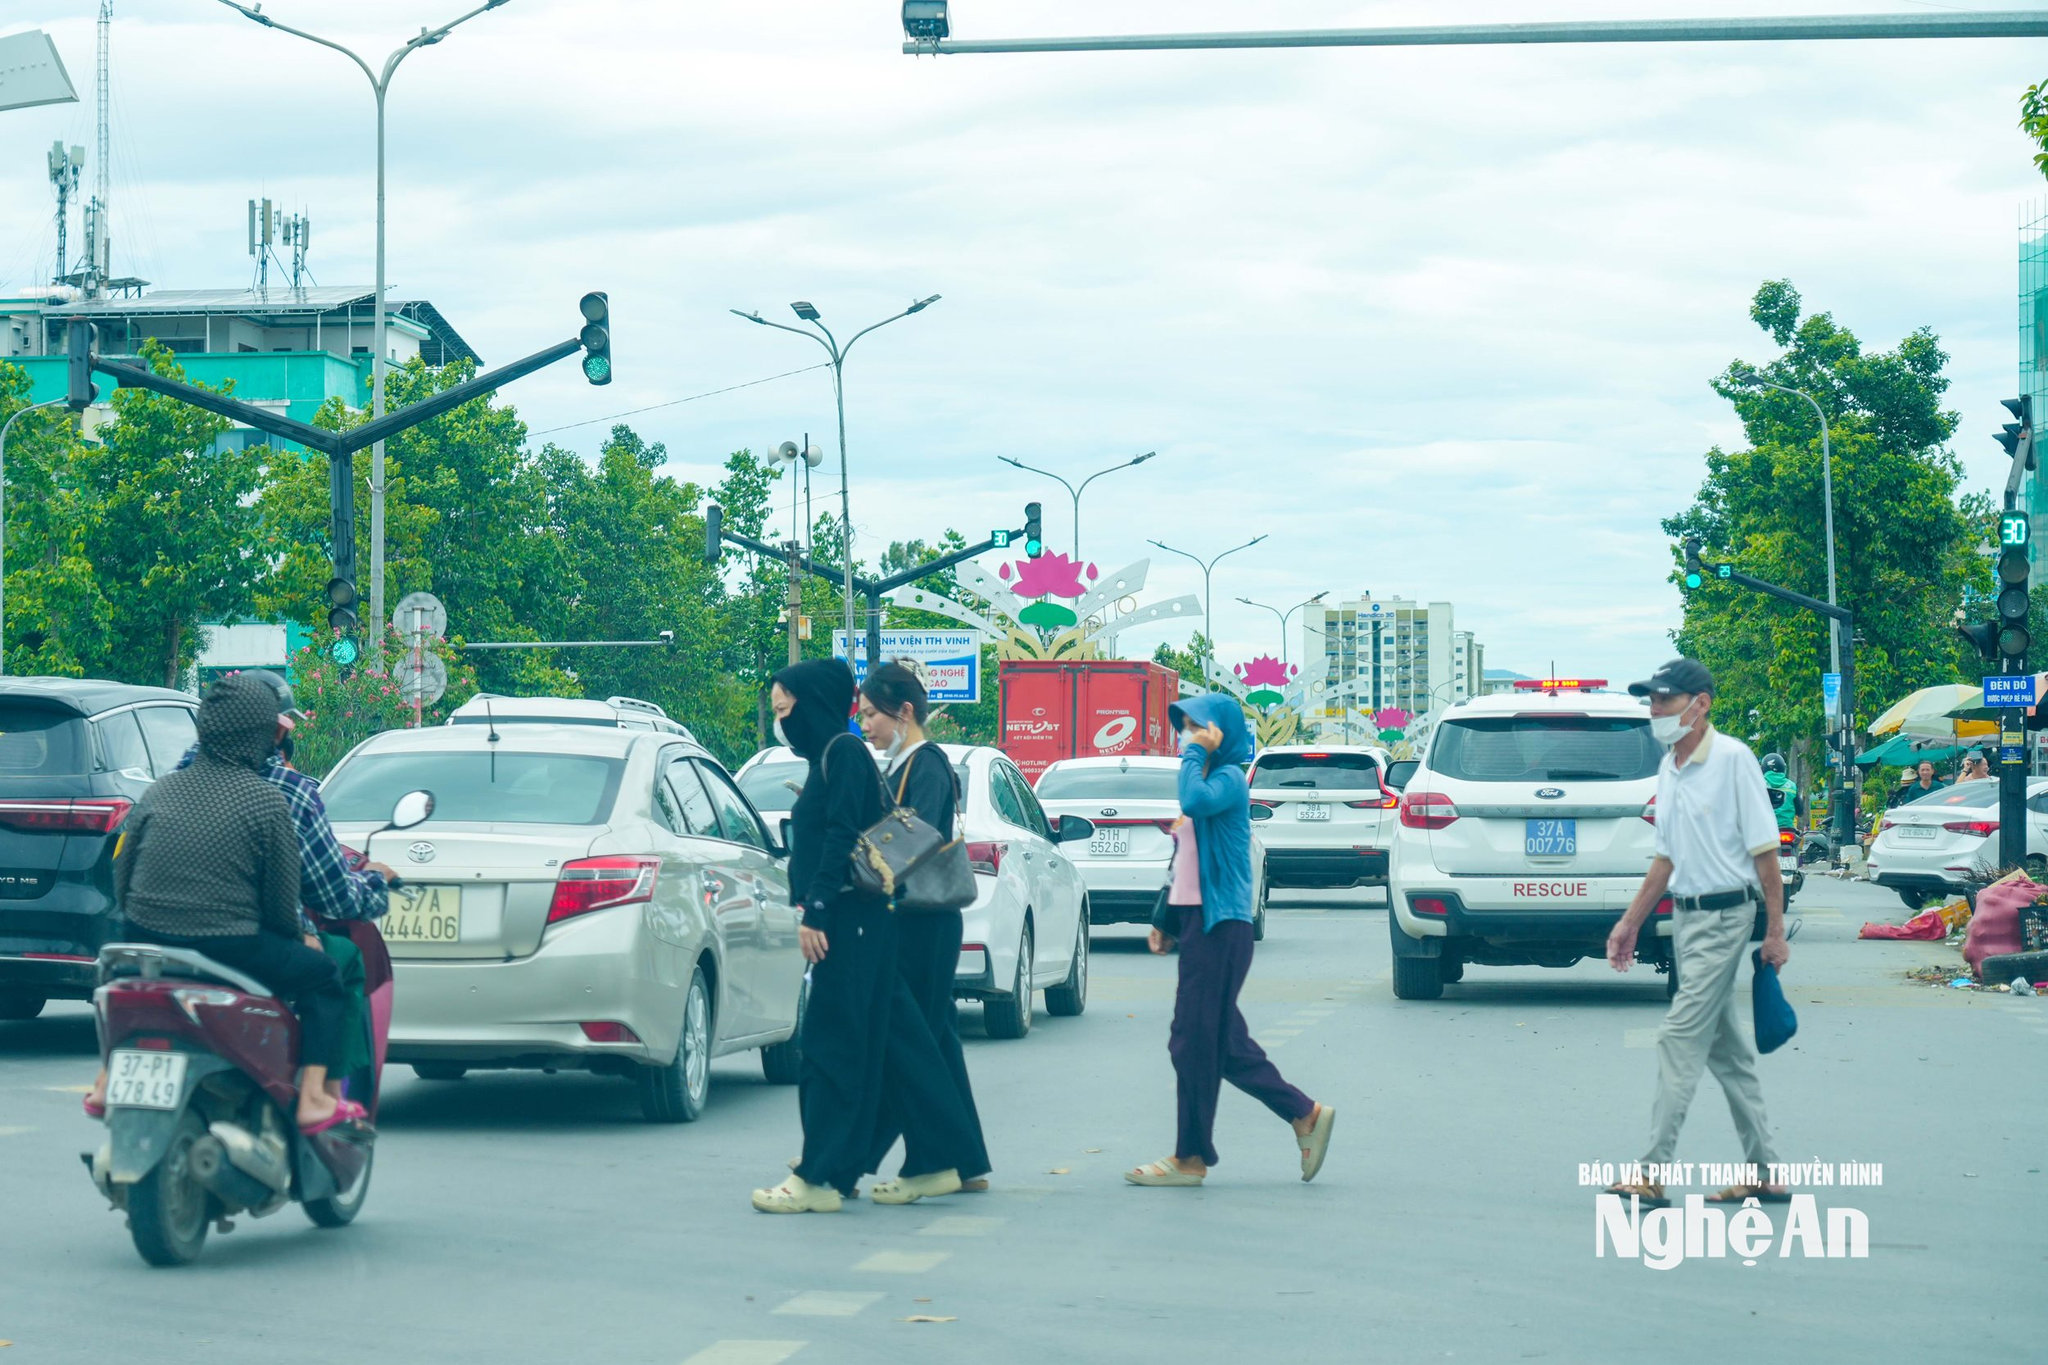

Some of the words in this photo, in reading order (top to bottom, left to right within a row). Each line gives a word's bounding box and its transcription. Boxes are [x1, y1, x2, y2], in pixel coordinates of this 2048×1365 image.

[2003, 519, 2026, 544] 30
[994, 532, 1007, 546] 30
[900, 635, 922, 648] VIỆN
[925, 637, 942, 645] TTH
[945, 637, 970, 645] VINH
[940, 667, 965, 679] NGHỆ
[1990, 678, 2010, 691] ĐÈN
[2013, 676, 2027, 690] ĐỎ
[1540, 789, 1559, 797] Ford
[1099, 829, 1120, 841] 51H
[1537, 821, 1564, 837] 37A
[1091, 841, 1127, 853] 552.60
[1526, 838, 1575, 853] 007.76
[1513, 883, 1588, 897] RESCUE
[384, 916, 457, 940] 444.06
[120, 1055, 172, 1079] 37-P1
[110, 1079, 175, 1104] 478.49
